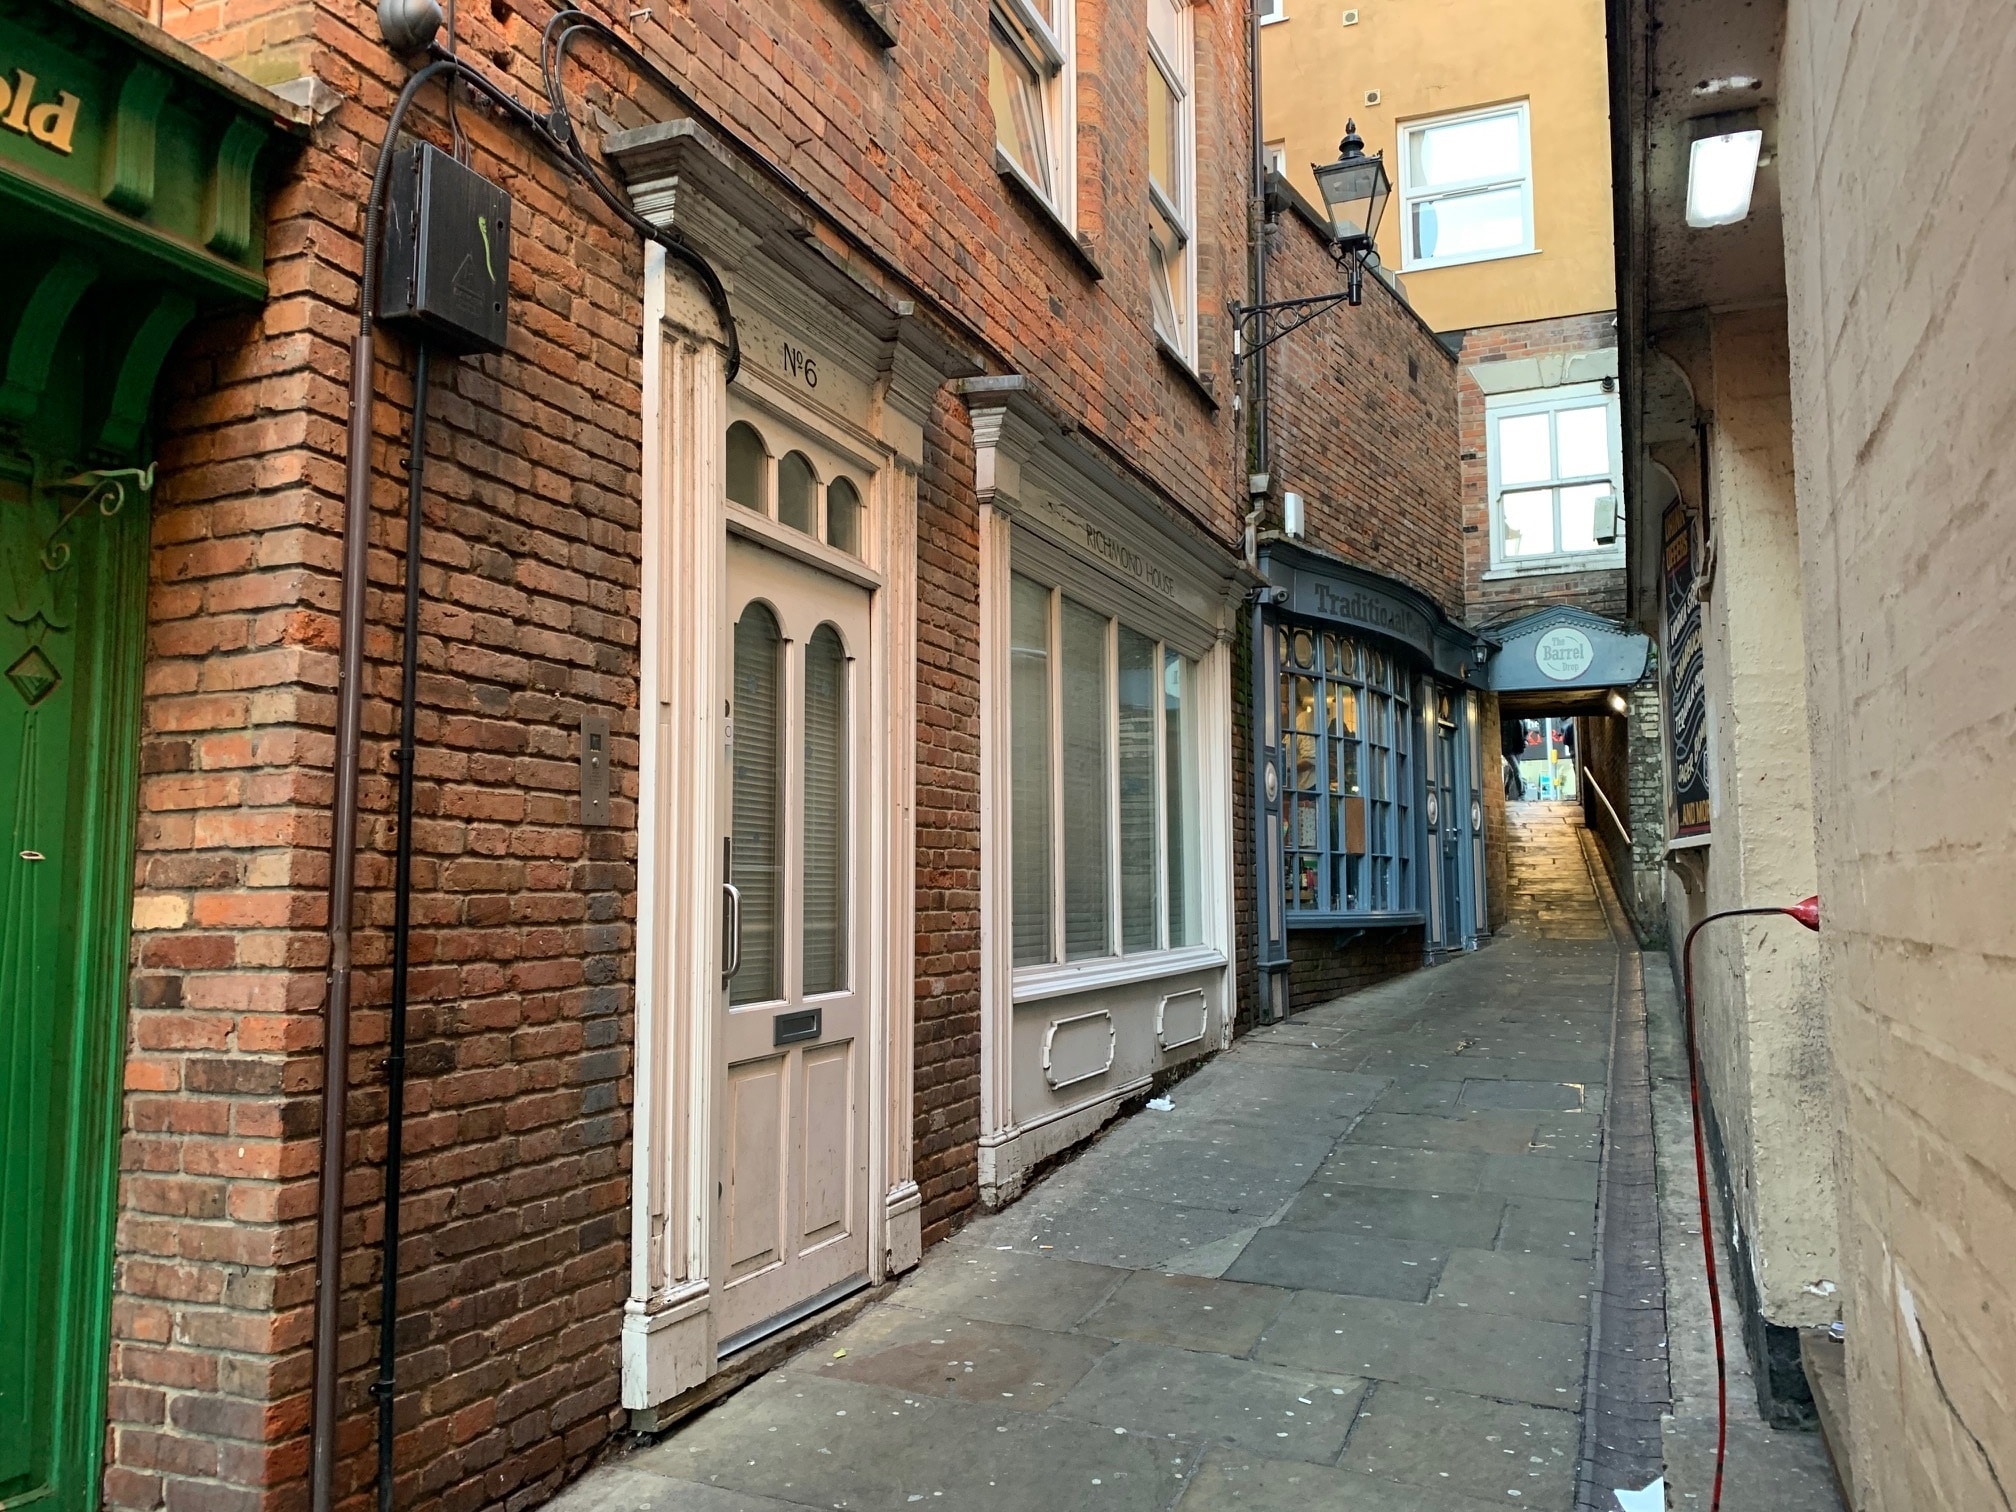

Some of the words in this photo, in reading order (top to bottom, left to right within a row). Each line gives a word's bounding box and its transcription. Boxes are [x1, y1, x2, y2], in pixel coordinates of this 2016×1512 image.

[1085, 522, 1143, 577] RICHMOND
[1146, 562, 1175, 598] HOUSE
[1552, 637, 1565, 646] The
[1542, 643, 1584, 661] Barrel
[1562, 662, 1580, 672] Drop
